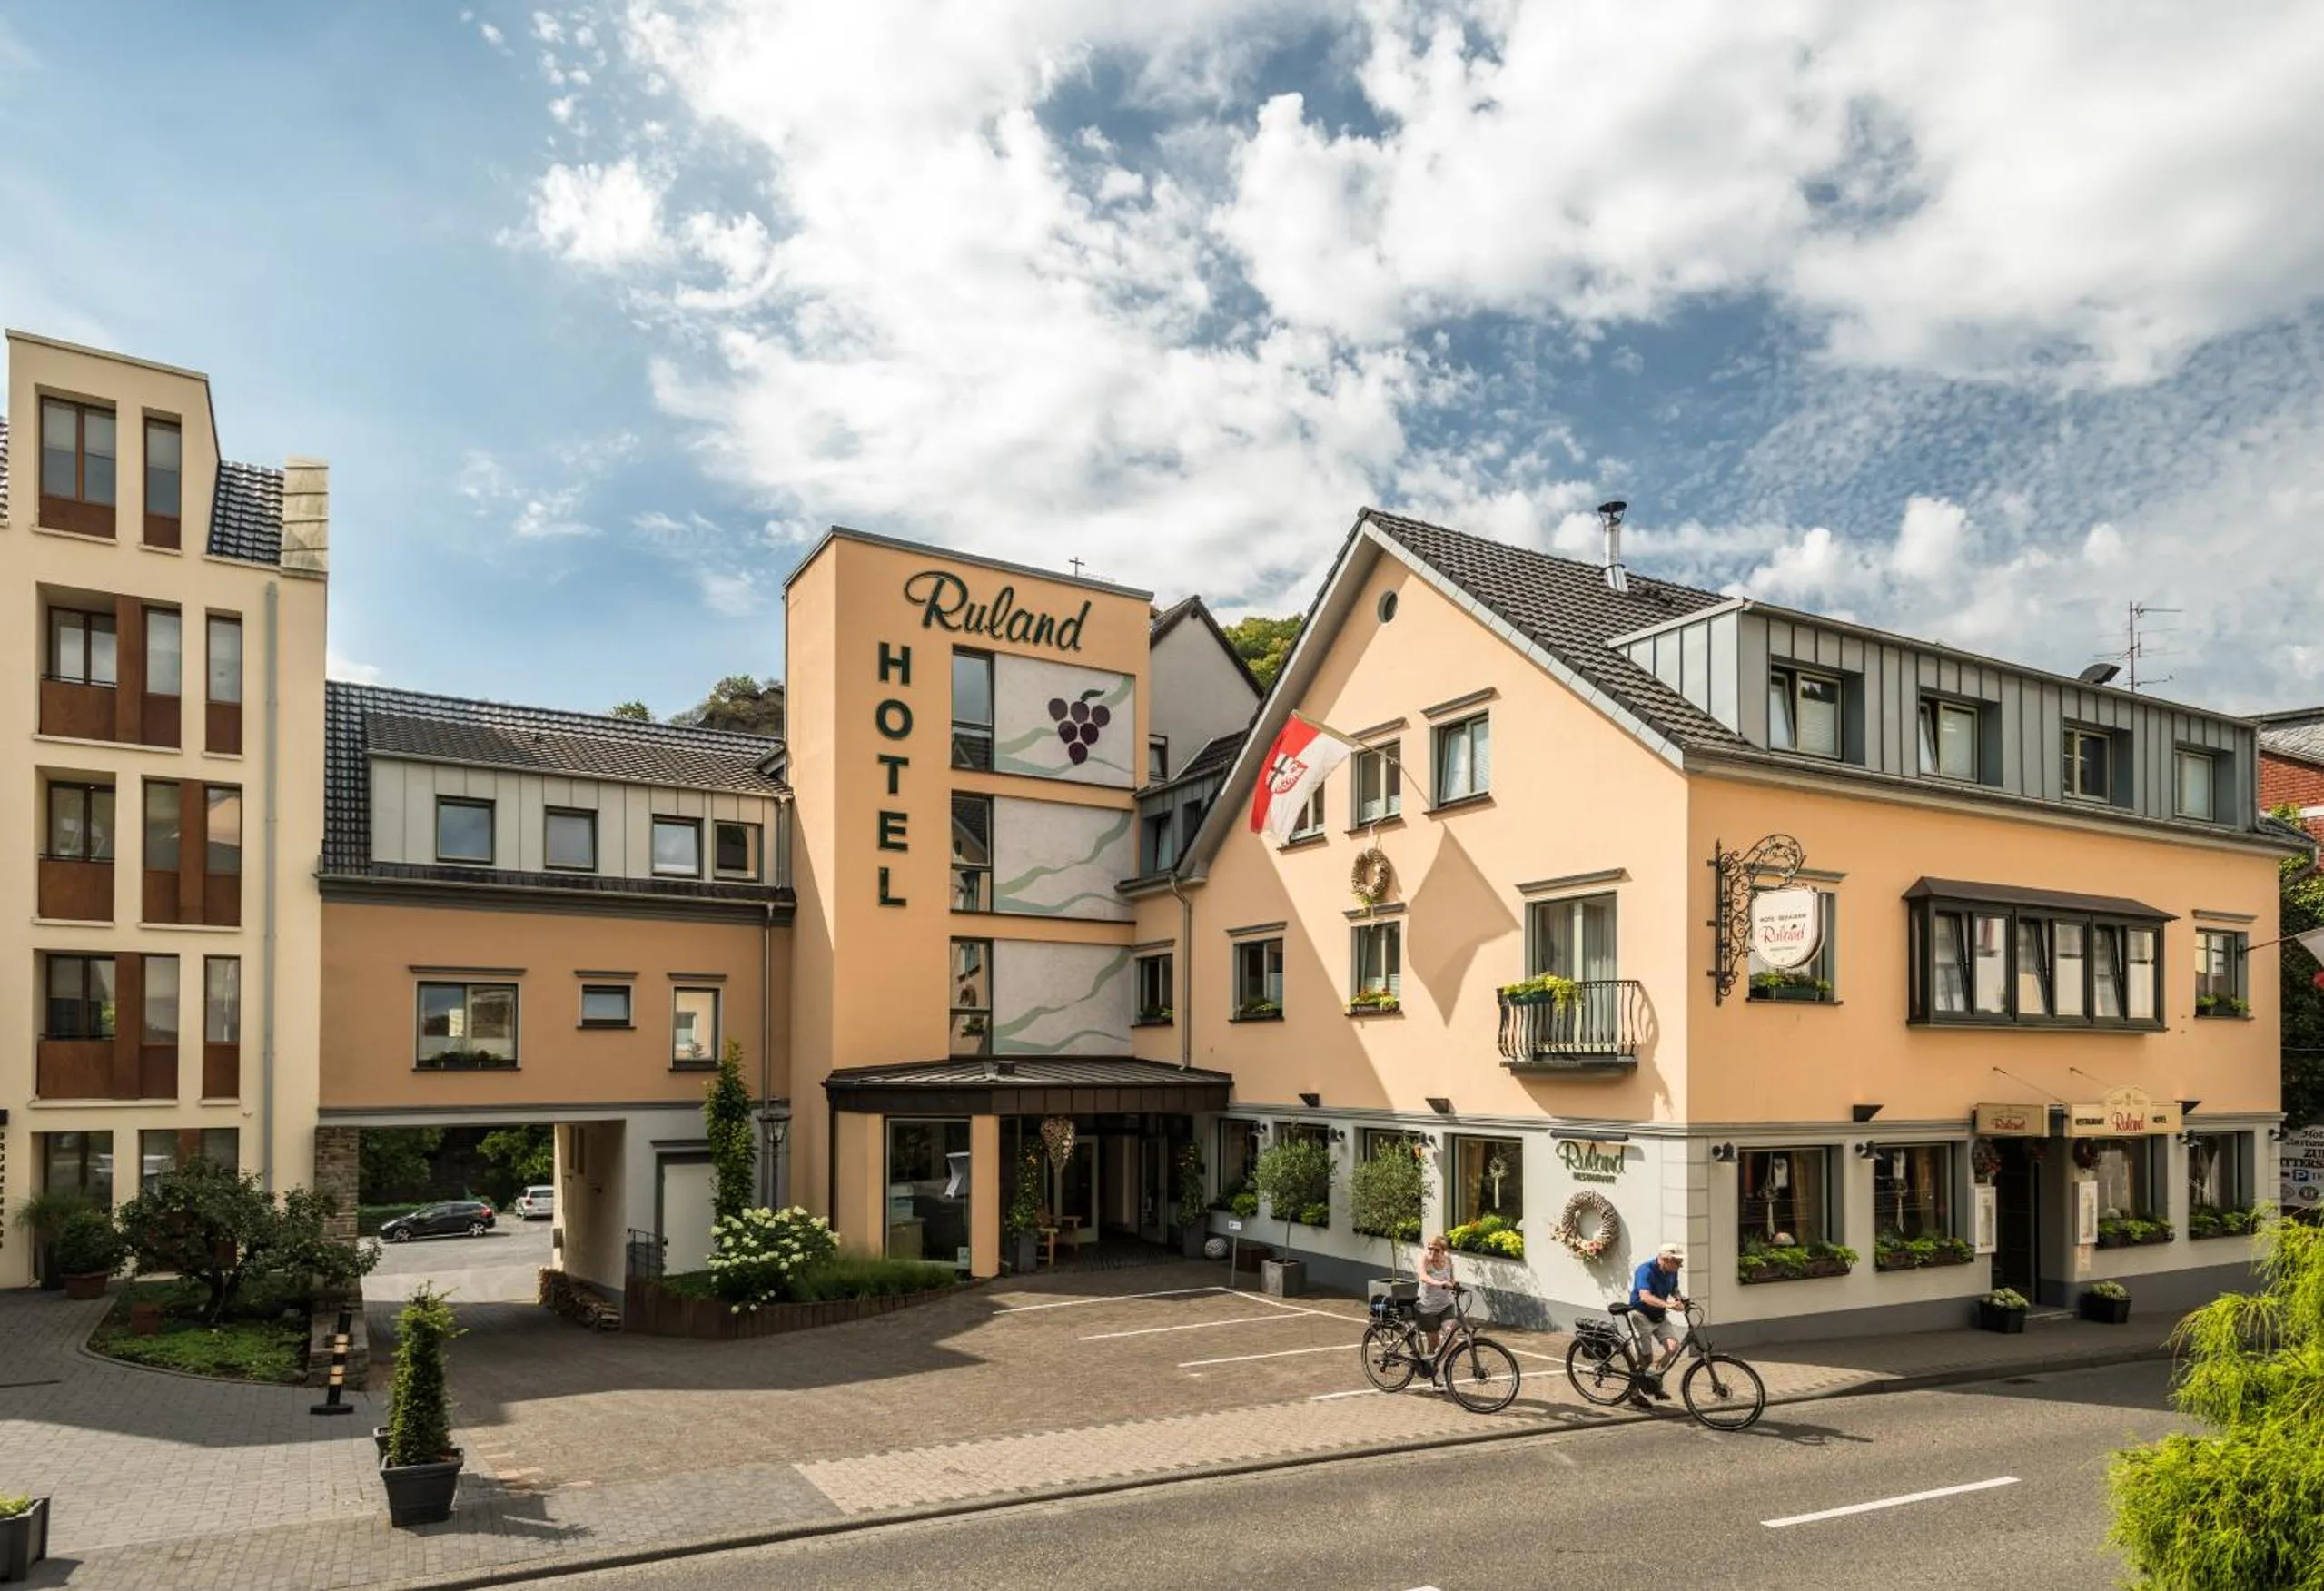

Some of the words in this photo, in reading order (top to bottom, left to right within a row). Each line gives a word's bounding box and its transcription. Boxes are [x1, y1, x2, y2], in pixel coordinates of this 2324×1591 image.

[905, 570, 1091, 651] Ruland
[875, 641, 914, 906] HOTEL
[1761, 923, 1805, 943] Ruland
[1991, 1118, 2026, 1130] Ruland
[2075, 1118, 2105, 1126] RESTAURANT
[2111, 1111, 2145, 1131] Ruland
[2152, 1115, 2168, 1123] HOTEL
[1556, 1140, 1626, 1173] Ruland
